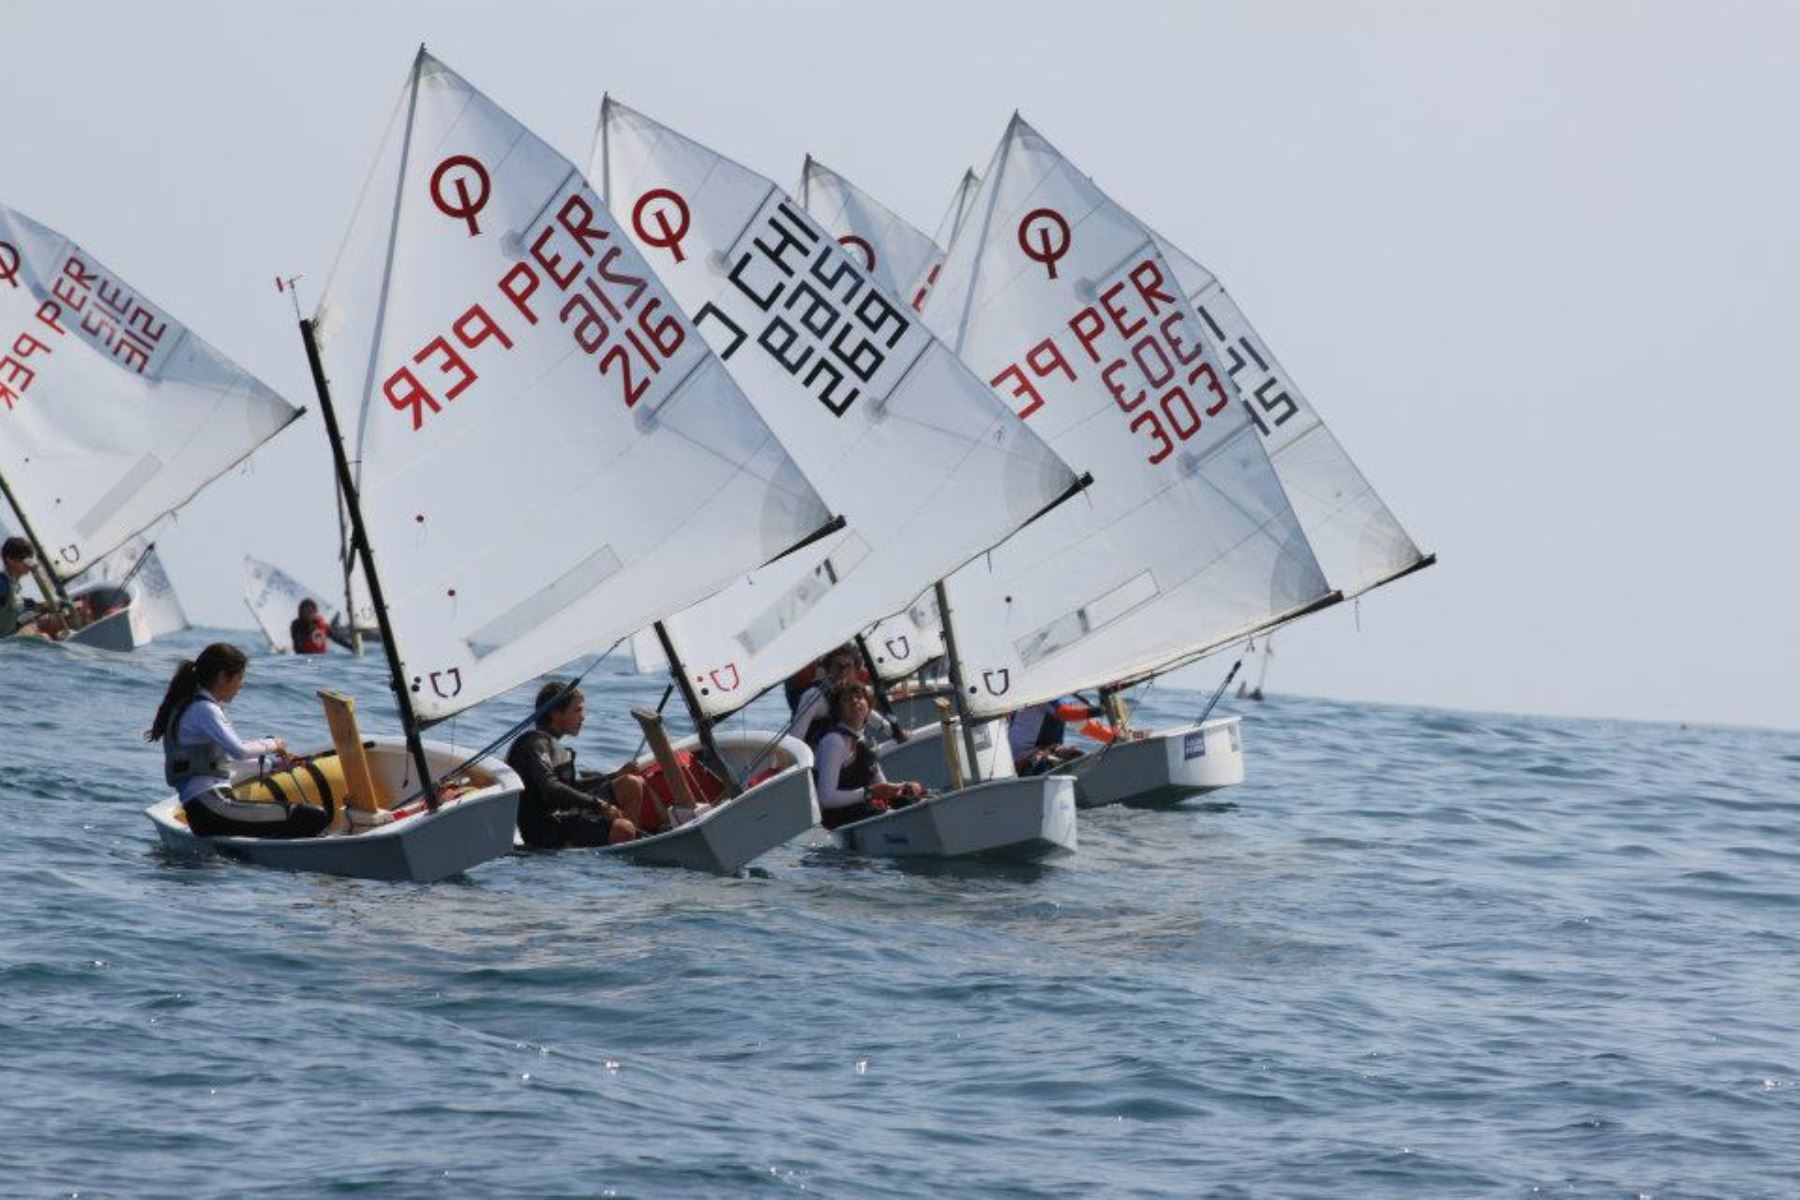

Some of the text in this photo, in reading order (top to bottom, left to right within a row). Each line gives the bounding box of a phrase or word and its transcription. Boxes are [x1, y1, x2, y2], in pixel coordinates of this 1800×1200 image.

[35, 256, 98, 335] PER
[498, 194, 610, 326] PER
[727, 202, 820, 313] CHI
[112, 306, 167, 374] 312
[599, 297, 686, 408] 216
[802, 288, 910, 418] 269
[1067, 260, 1176, 364] PER
[1130, 362, 1228, 465] 303
